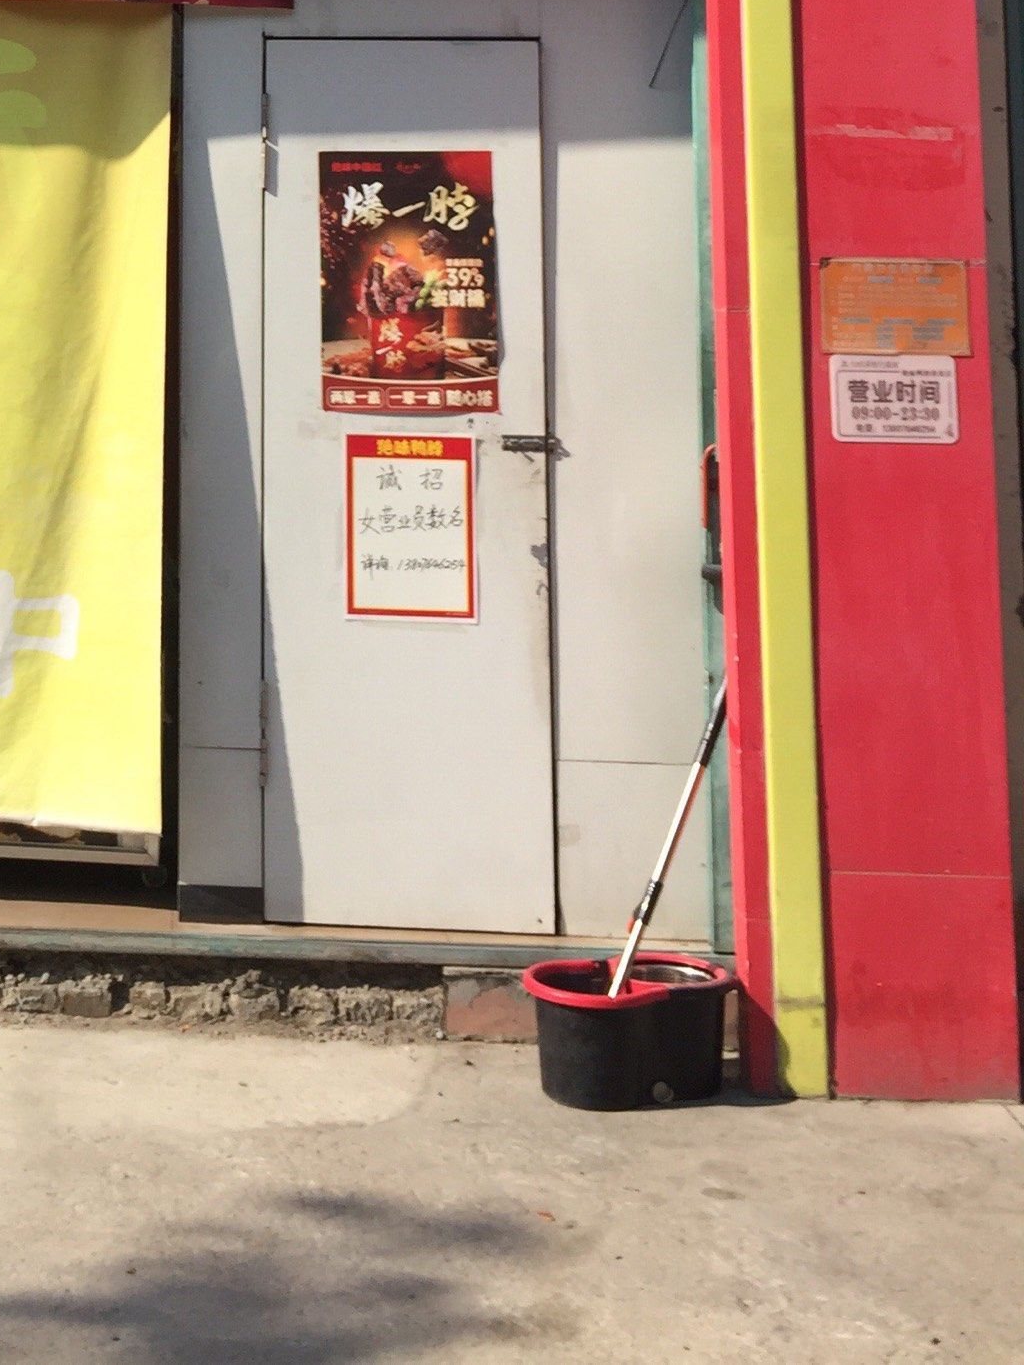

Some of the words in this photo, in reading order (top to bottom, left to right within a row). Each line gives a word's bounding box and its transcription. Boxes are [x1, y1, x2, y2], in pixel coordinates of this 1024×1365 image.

[847, 380, 941, 404] 营业时间
[376, 438, 445, 457] 绝味鸭脖
